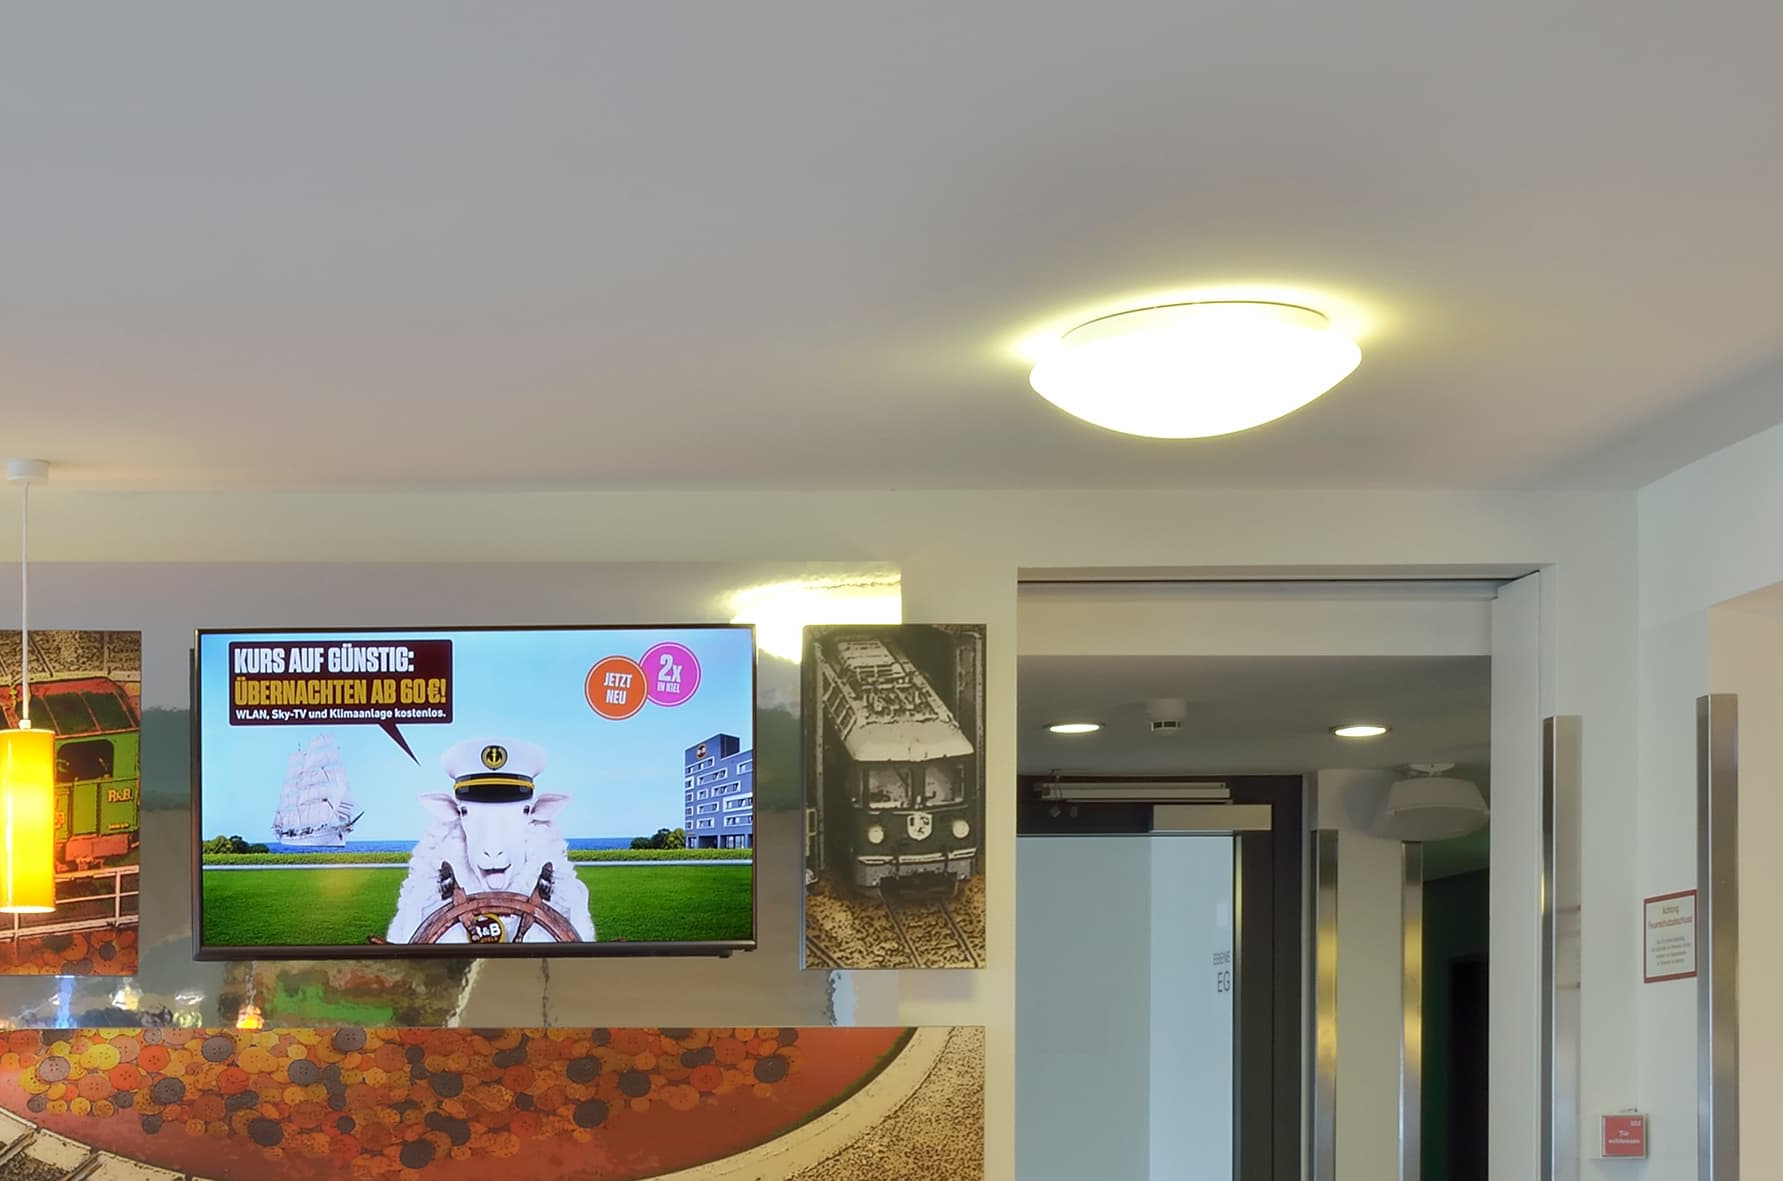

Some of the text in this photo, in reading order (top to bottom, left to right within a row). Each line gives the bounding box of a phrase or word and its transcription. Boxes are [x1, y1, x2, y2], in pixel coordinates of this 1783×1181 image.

[234, 643, 415, 674] KURS AUF GÜNSTIG:
[603, 672, 633, 688] JETZT
[234, 676, 366, 706] ÜBERNACHTEN
[370, 679, 397, 704] AB
[605, 690, 627, 704] NEU
[235, 708, 446, 721] WLAN, Sky-TV und Klimaanlage kostenlos.
